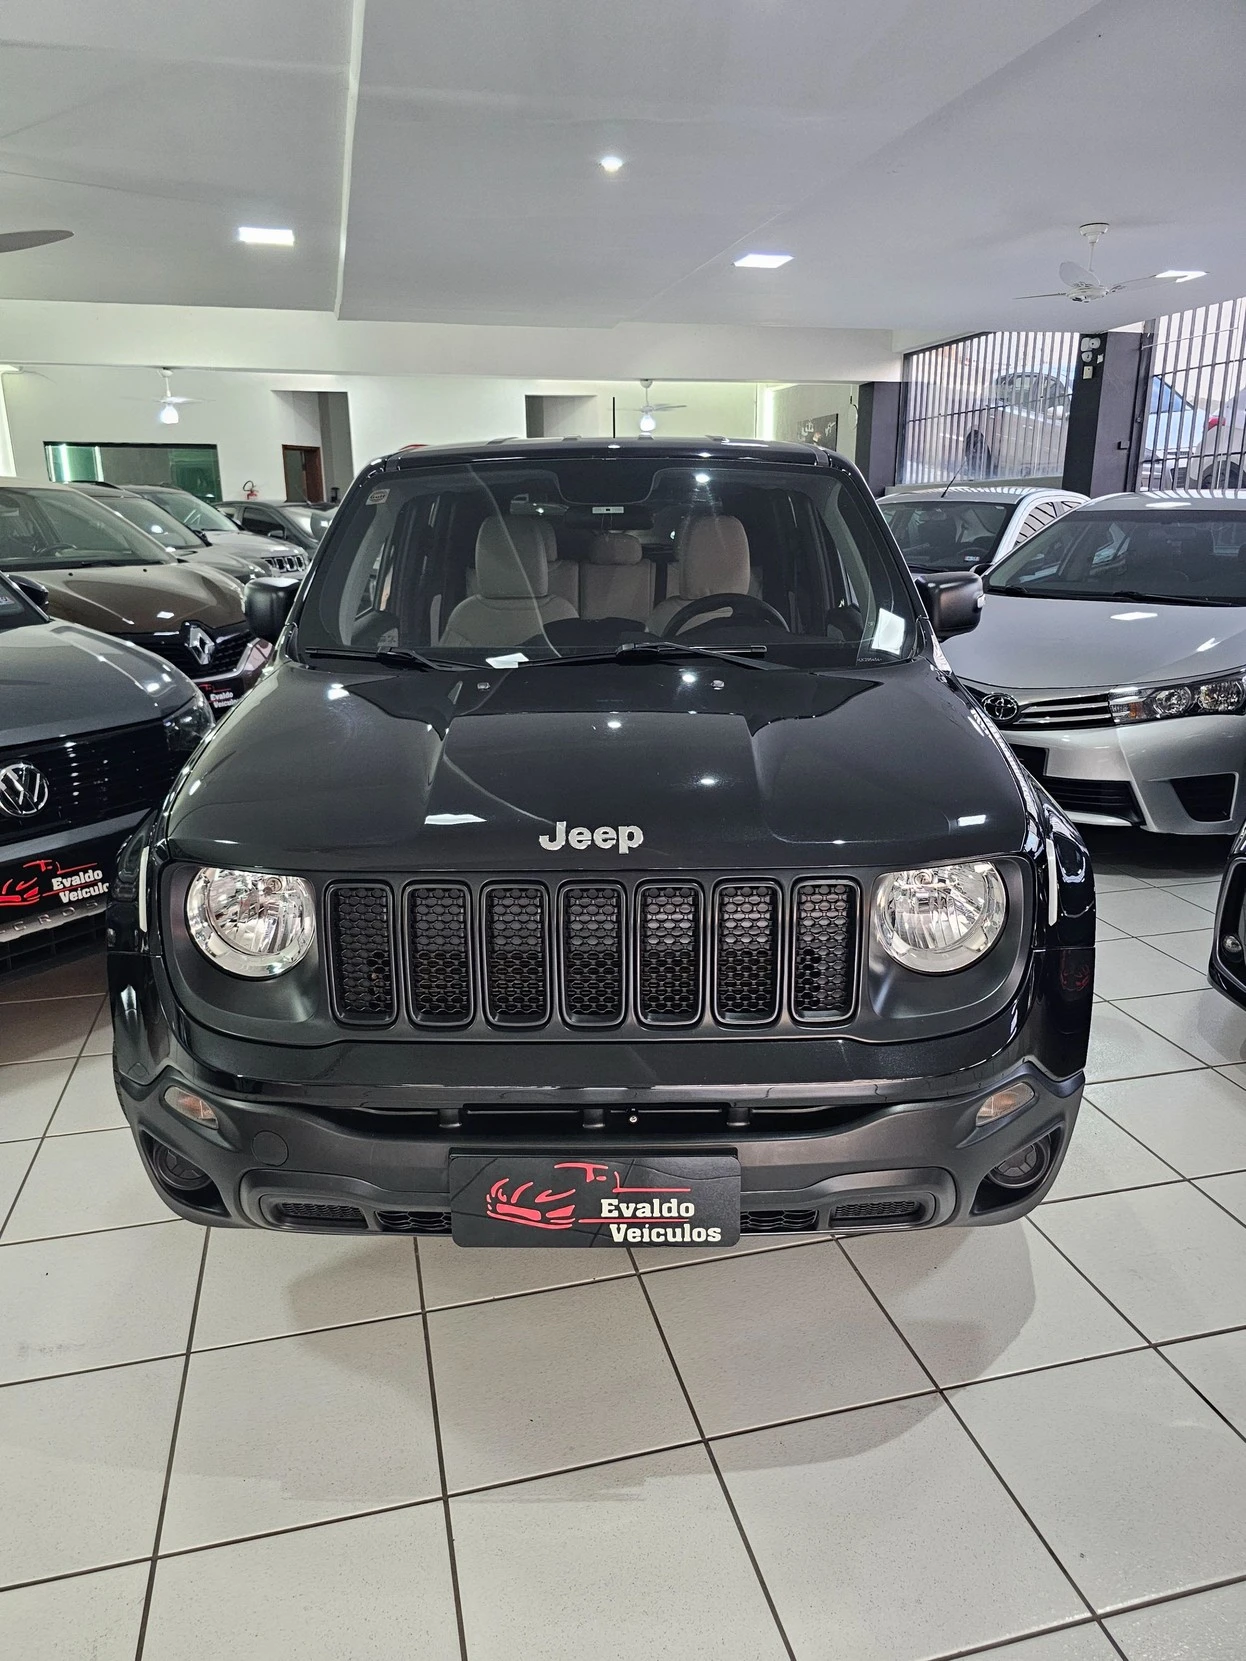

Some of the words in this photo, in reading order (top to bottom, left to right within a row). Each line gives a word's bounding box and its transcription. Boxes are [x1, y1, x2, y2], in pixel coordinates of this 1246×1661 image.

[539, 821, 644, 854] Jeep
[52, 869, 103, 891] Evaldo
[600, 1198, 695, 1217] Evaldo
